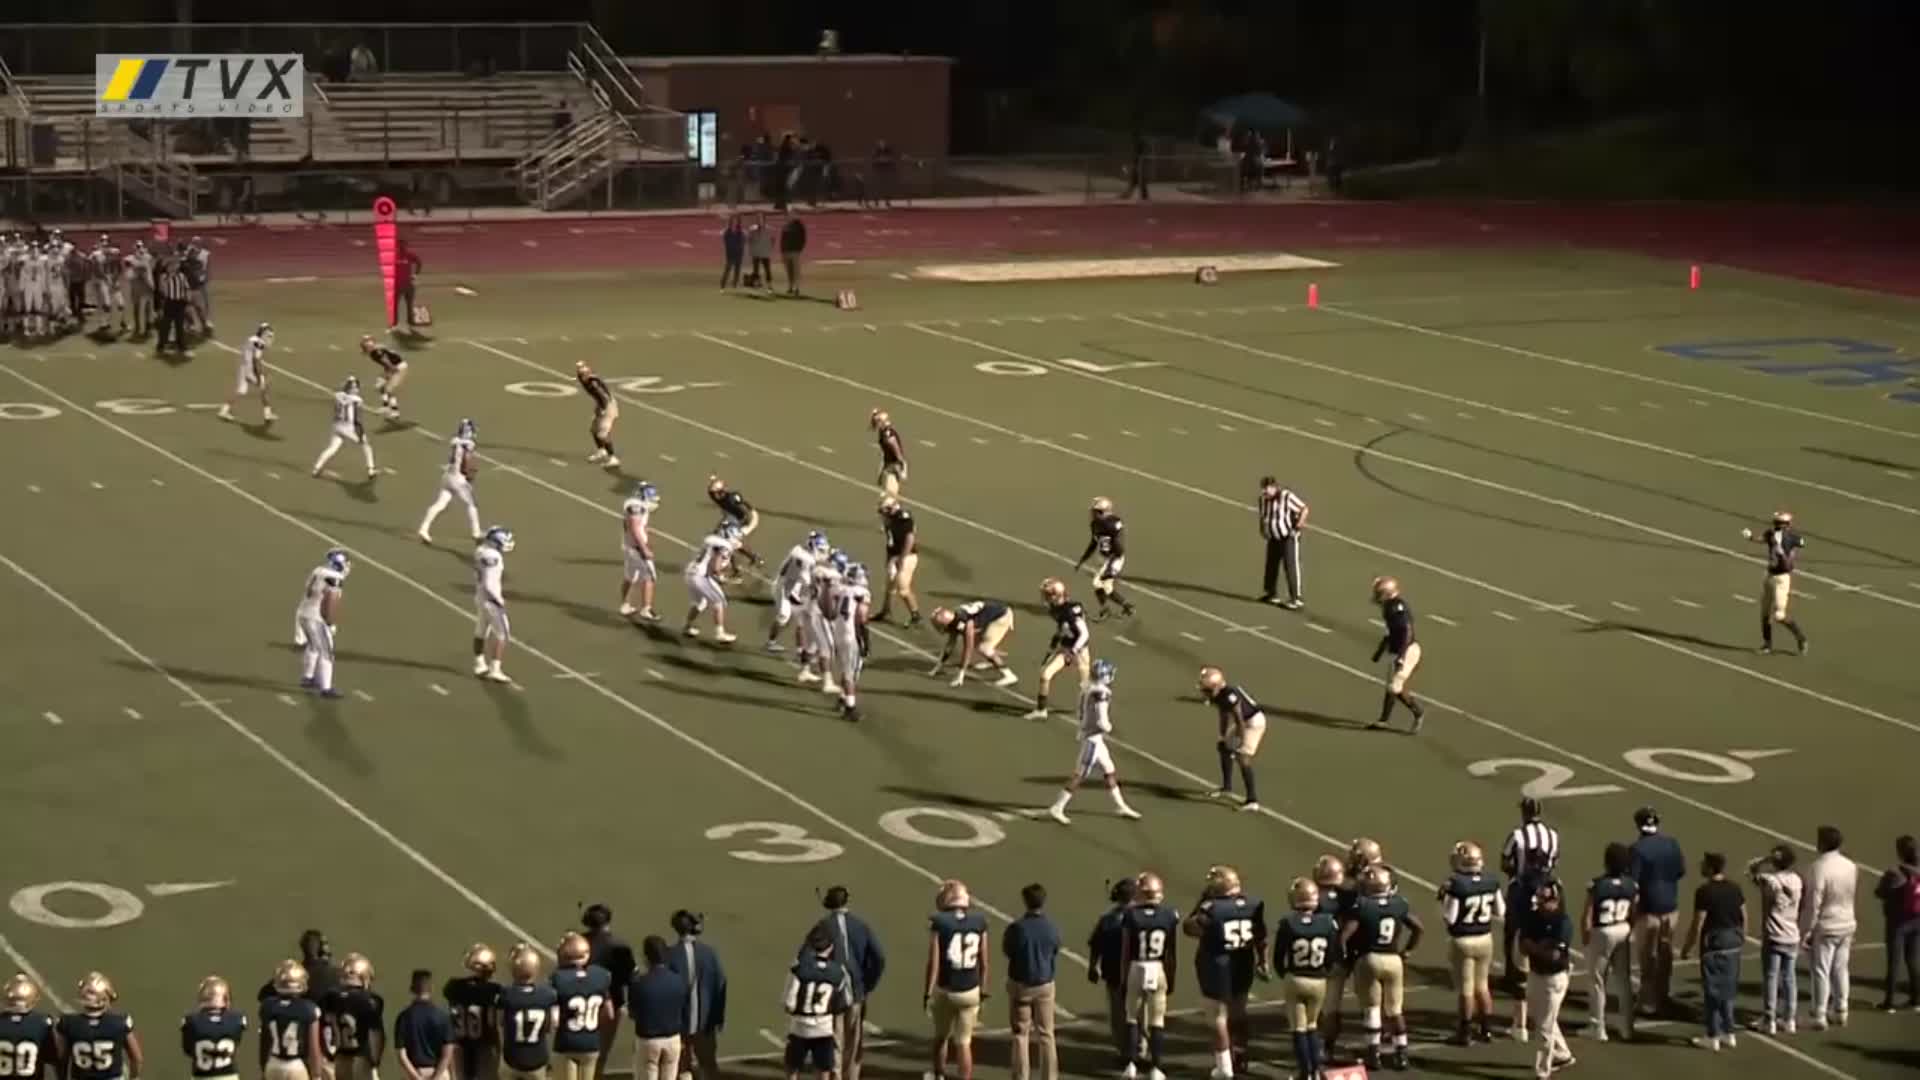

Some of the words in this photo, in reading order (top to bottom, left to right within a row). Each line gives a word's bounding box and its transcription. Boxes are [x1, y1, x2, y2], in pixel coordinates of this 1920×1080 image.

[1463, 893, 1496, 923] 75
[1138, 929, 1166, 959] 19
[1379, 918, 1398, 943] 9
[946, 932, 981, 969] 42
[1293, 939, 1328, 967] 26
[567, 994, 604, 1032] 30
[803, 981, 834, 1015] 13
[269, 1021, 299, 1056] 14
[513, 1008, 546, 1043] 17
[0, 1039, 37, 1076] 60
[73, 1040, 114, 1070] 65
[195, 1038, 236, 1070] 62
